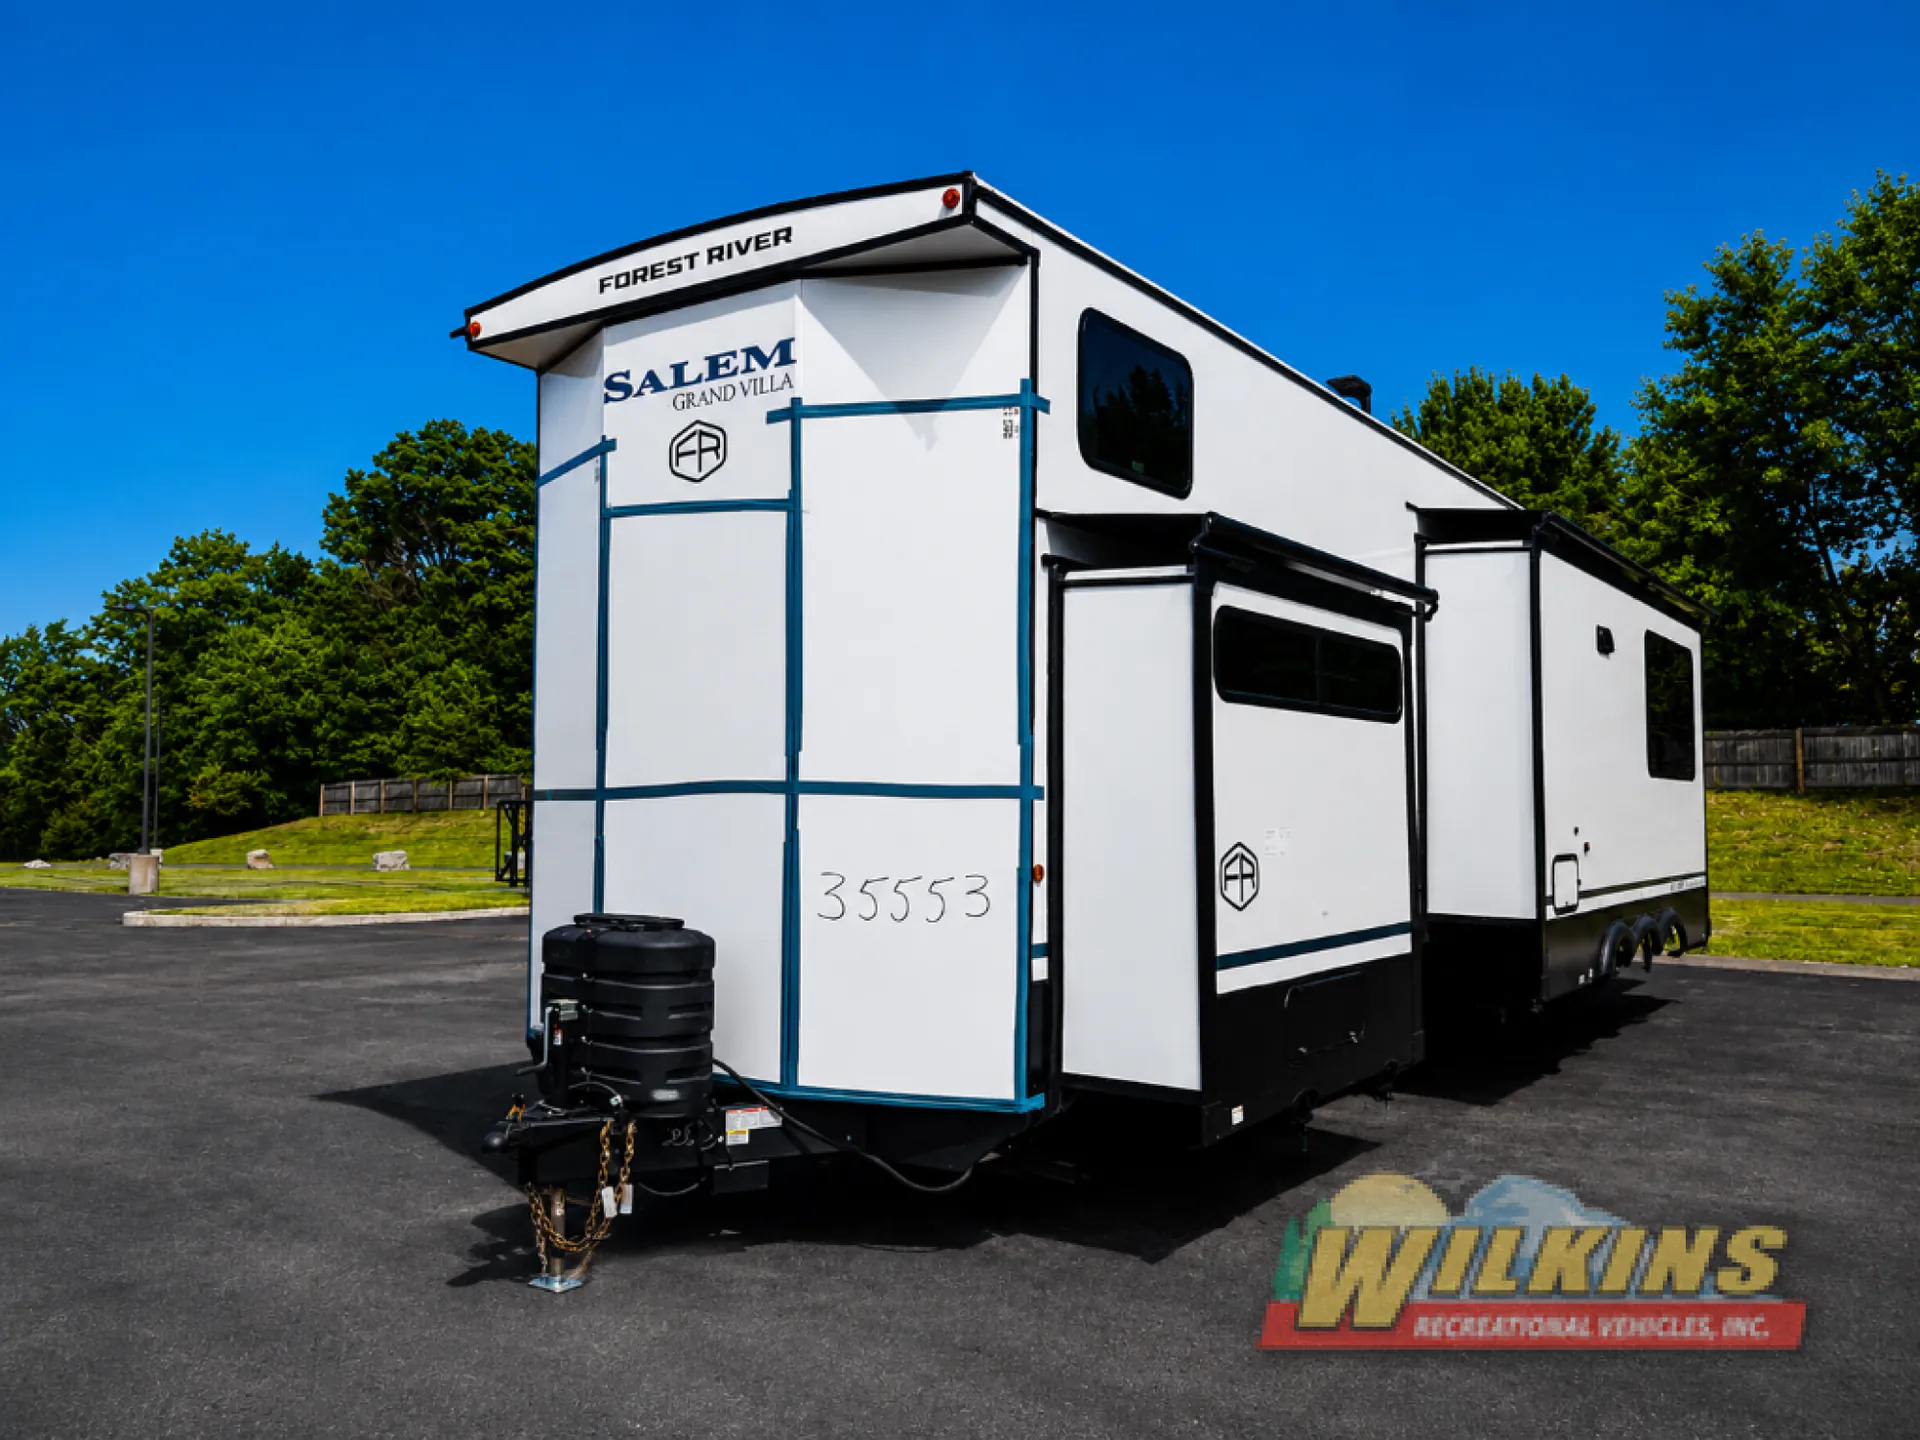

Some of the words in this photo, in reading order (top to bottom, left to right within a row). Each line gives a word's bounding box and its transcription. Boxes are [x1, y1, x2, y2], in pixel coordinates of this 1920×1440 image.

[599, 252, 700, 294] FOREST
[706, 226, 792, 265] RIVER
[603, 337, 797, 404] SALEM
[672, 383, 736, 411] GRAND
[739, 372, 794, 397] VILLA
[817, 871, 991, 923] 35553
